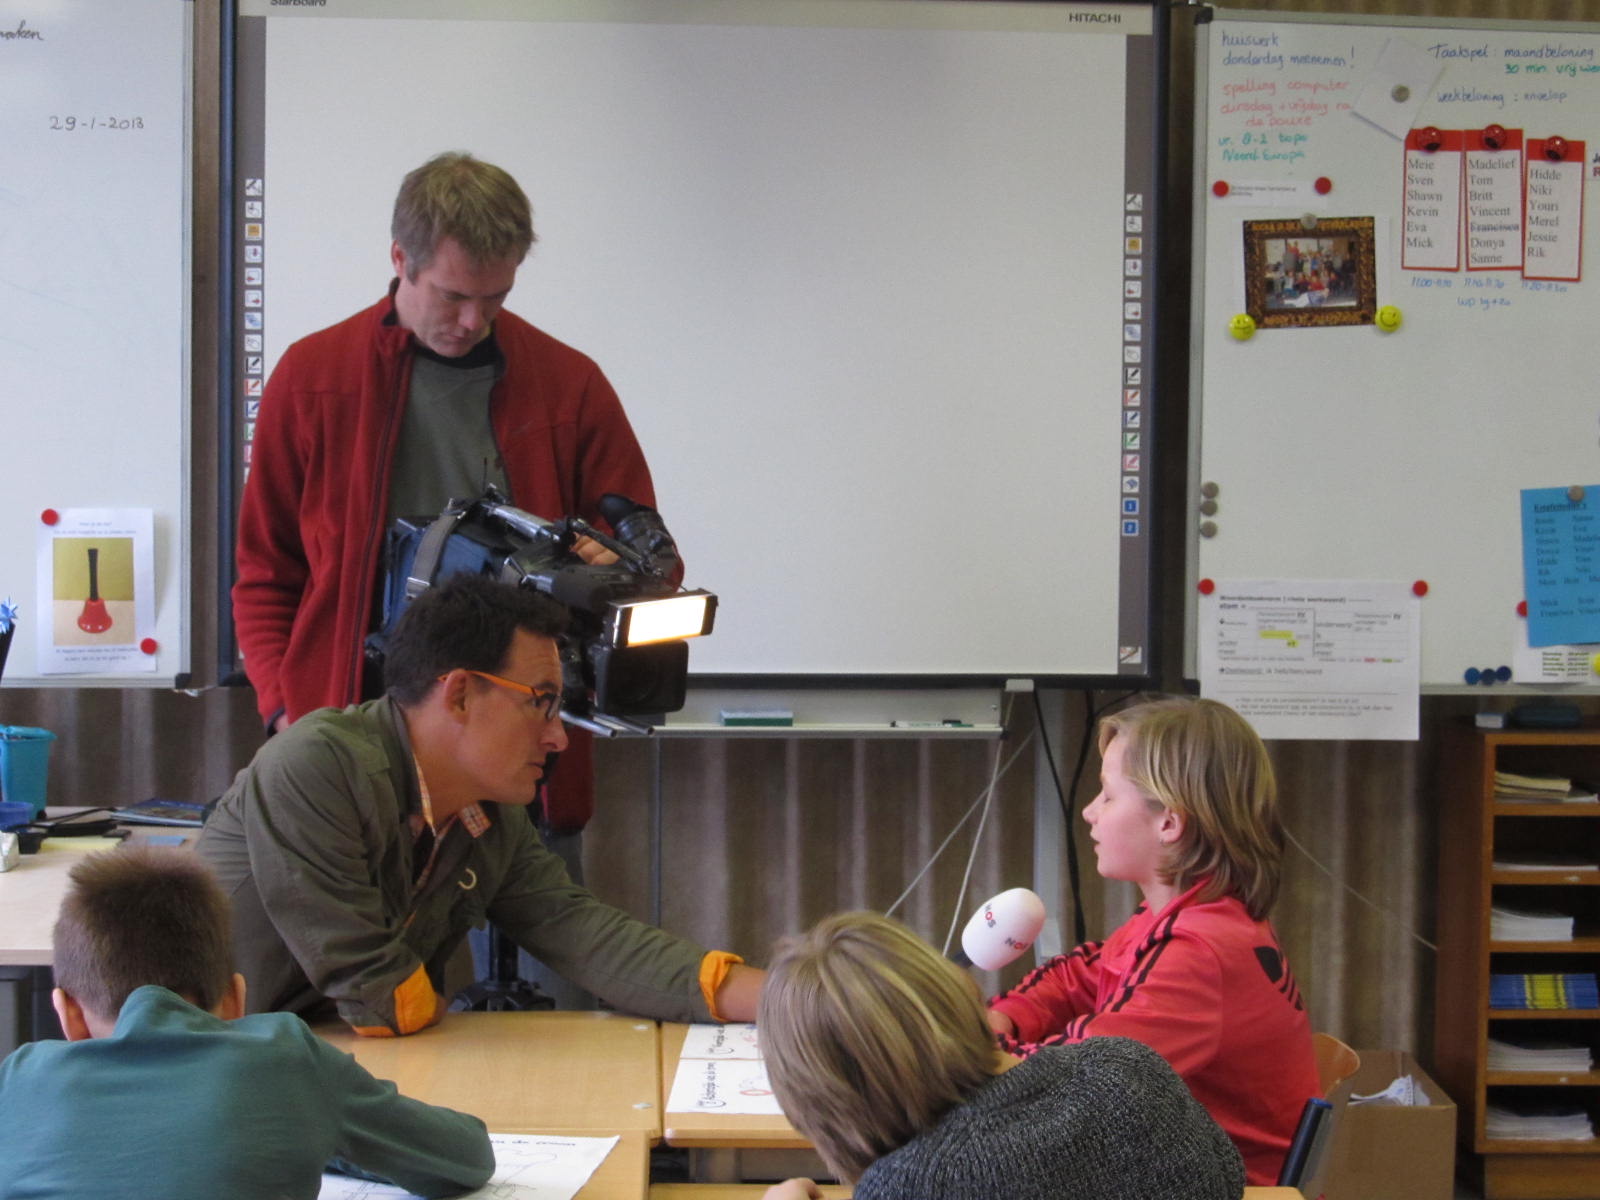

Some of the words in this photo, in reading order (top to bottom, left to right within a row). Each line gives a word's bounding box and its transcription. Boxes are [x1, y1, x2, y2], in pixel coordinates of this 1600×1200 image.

[1068, 13, 1121, 23] HITACHI
[1504, 44, 1593, 61] maandbeloning
[1222, 50, 1284, 70] donderdag
[1222, 80, 1276, 97] spelling
[1286, 81, 1350, 95] computer
[1468, 158, 1516, 170] Madelief
[1469, 175, 1494, 185] Tom
[1529, 169, 1562, 181] Hidde
[1407, 176, 1434, 186] Sven
[1407, 191, 1443, 201] Shawn
[1469, 190, 1494, 201] Britt
[1529, 185, 1553, 196] Niki
[1407, 205, 1439, 217] Kevin
[1469, 206, 1511, 217] Vincent
[1407, 222, 1427, 232] Eva
[1528, 216, 1560, 227] Merel
[1528, 231, 1558, 243] Jessie
[1406, 238, 1434, 249] Mick
[1527, 247, 1547, 258] Rik
[1470, 253, 1503, 264] Sanne
